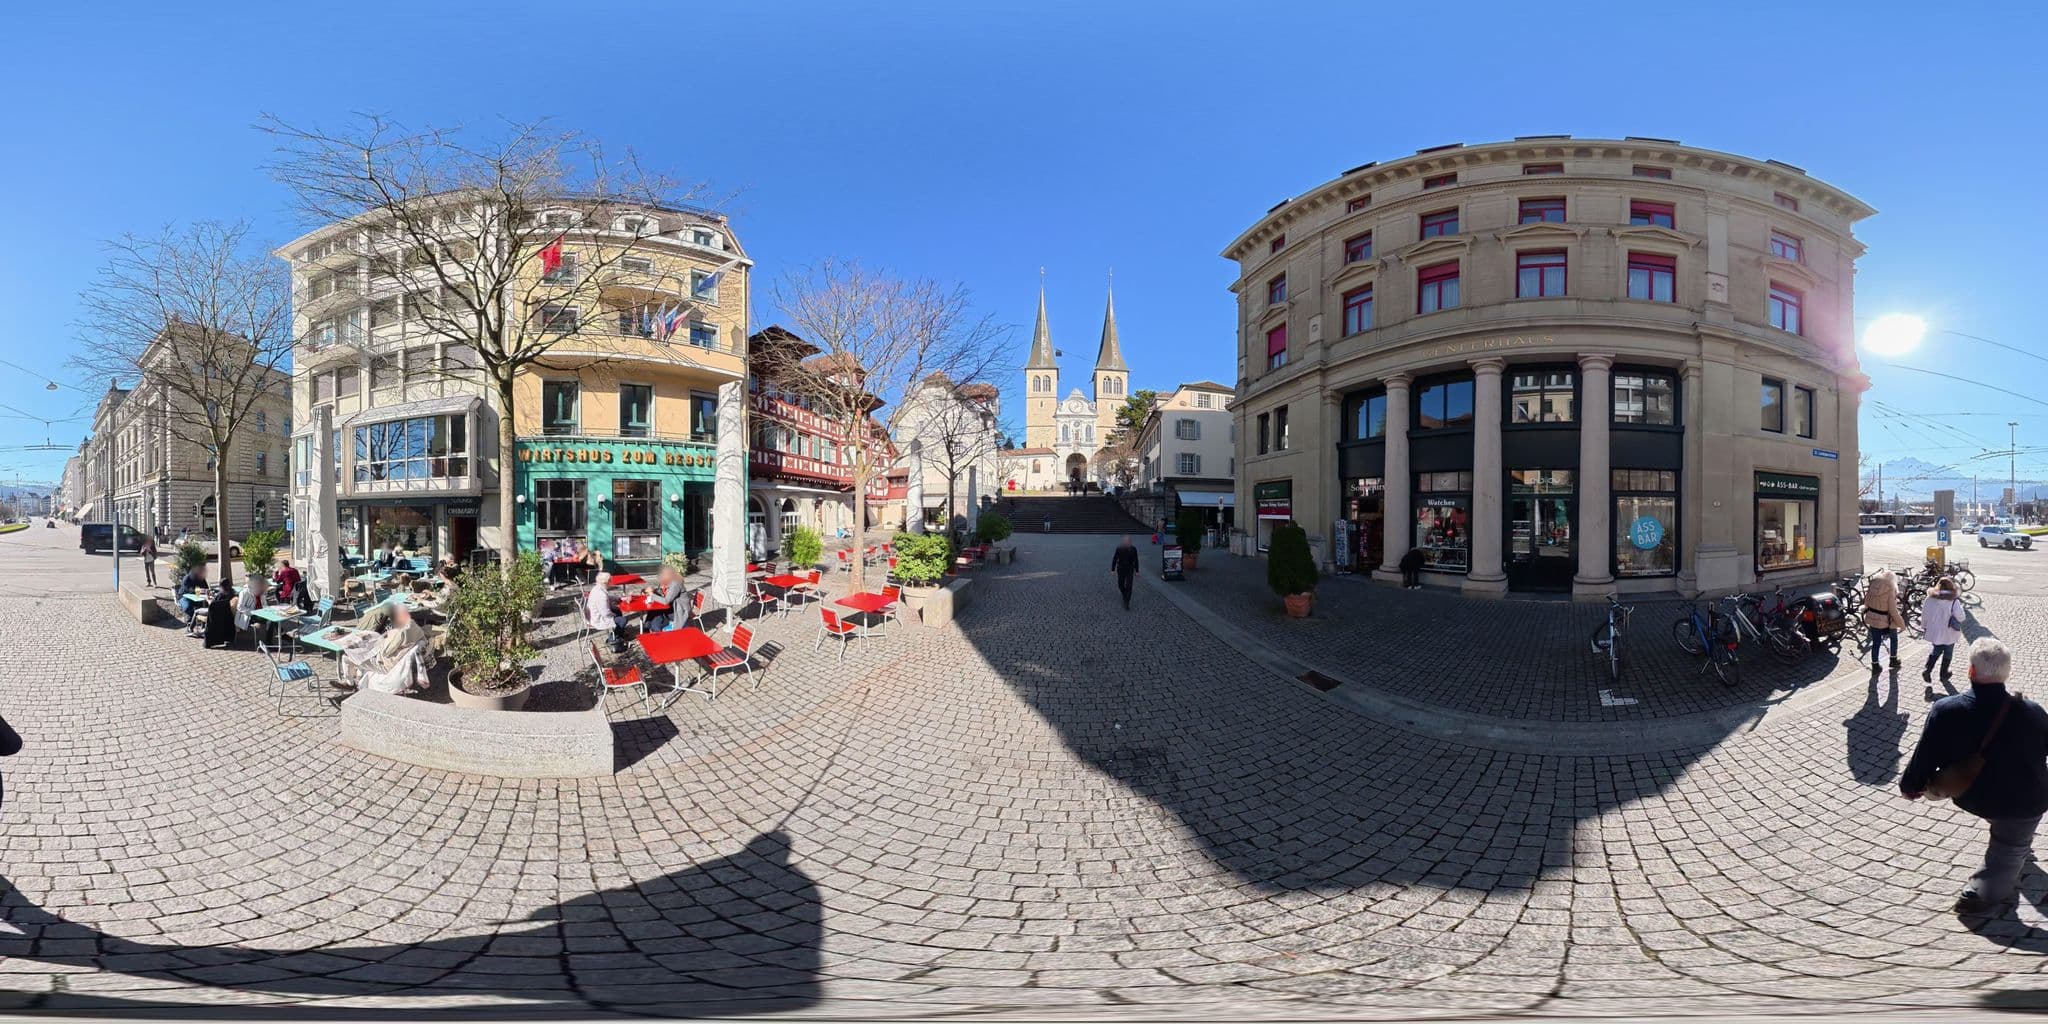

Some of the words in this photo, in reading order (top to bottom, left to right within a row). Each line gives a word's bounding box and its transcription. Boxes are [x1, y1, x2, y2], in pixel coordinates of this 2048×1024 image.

[518, 448, 614, 464] WIRTSHUS
[622, 450, 657, 465] ZUM
[664, 452, 716, 468] REBST
[1637, 532, 1657, 545] BAR
[1939, 531, 1946, 540] P
